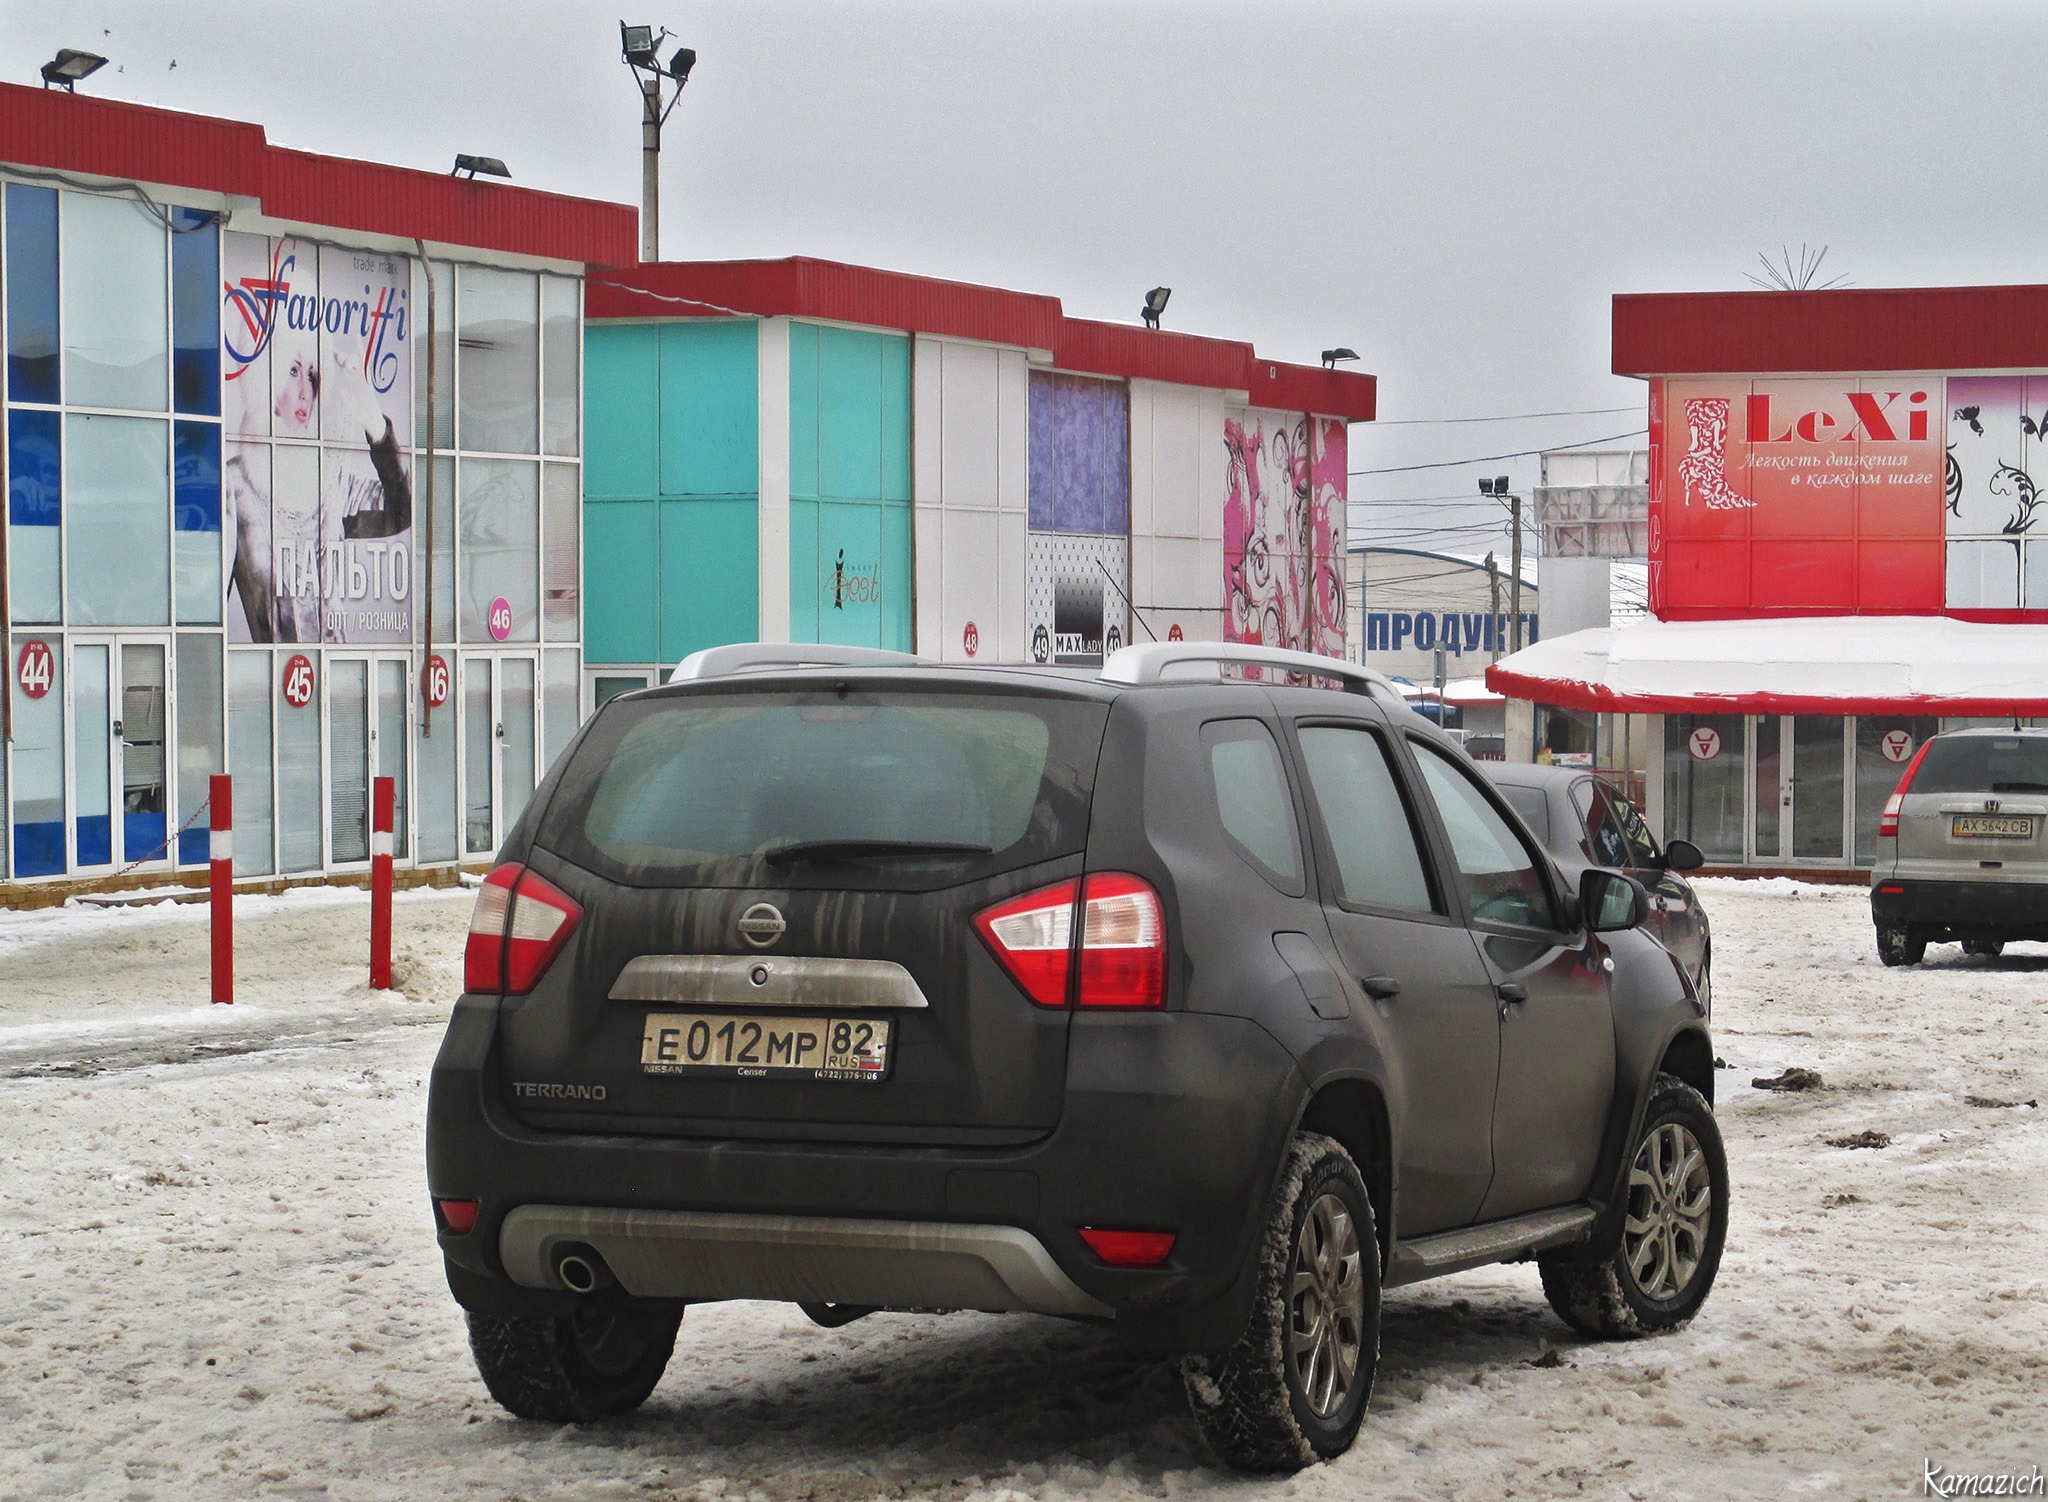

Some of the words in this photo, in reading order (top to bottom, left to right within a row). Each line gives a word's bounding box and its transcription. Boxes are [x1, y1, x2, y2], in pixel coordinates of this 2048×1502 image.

[353, 256, 375, 272] trade
[378, 258, 399, 276] mark
[1739, 391, 1930, 443] LeXi
[1738, 452, 1821, 470] Легкость
[1826, 451, 1908, 469] движения
[1791, 476, 1800, 485] в
[1806, 469, 1881, 488] каждом
[1888, 474, 1933, 487] шаге
[276, 539, 409, 600] ПАЛЬТО
[327, 611, 348, 630] ОПТ
[359, 611, 409, 634] РОЗНИЦА
[492, 608, 510, 630] 46
[965, 633, 977, 652] 48
[1034, 636, 1048, 659] 49
[1056, 635, 1081, 653] MAX
[1082, 642, 1102, 652] LADY
[21, 652, 50, 691] 44
[286, 667, 312, 703] 45
[1961, 821, 1979, 833] AX
[1981, 821, 2008, 833] 5642
[2009, 822, 2029, 833] CB
[741, 922, 780, 931] NISSAN
[657, 1020, 818, 1065] E012MP
[832, 1022, 874, 1056] 82
[644, 1066, 683, 1075] NISSAN
[828, 1056, 859, 1068] RUS
[737, 1067, 768, 1077] Censer
[512, 1082, 607, 1101] TERRANO
